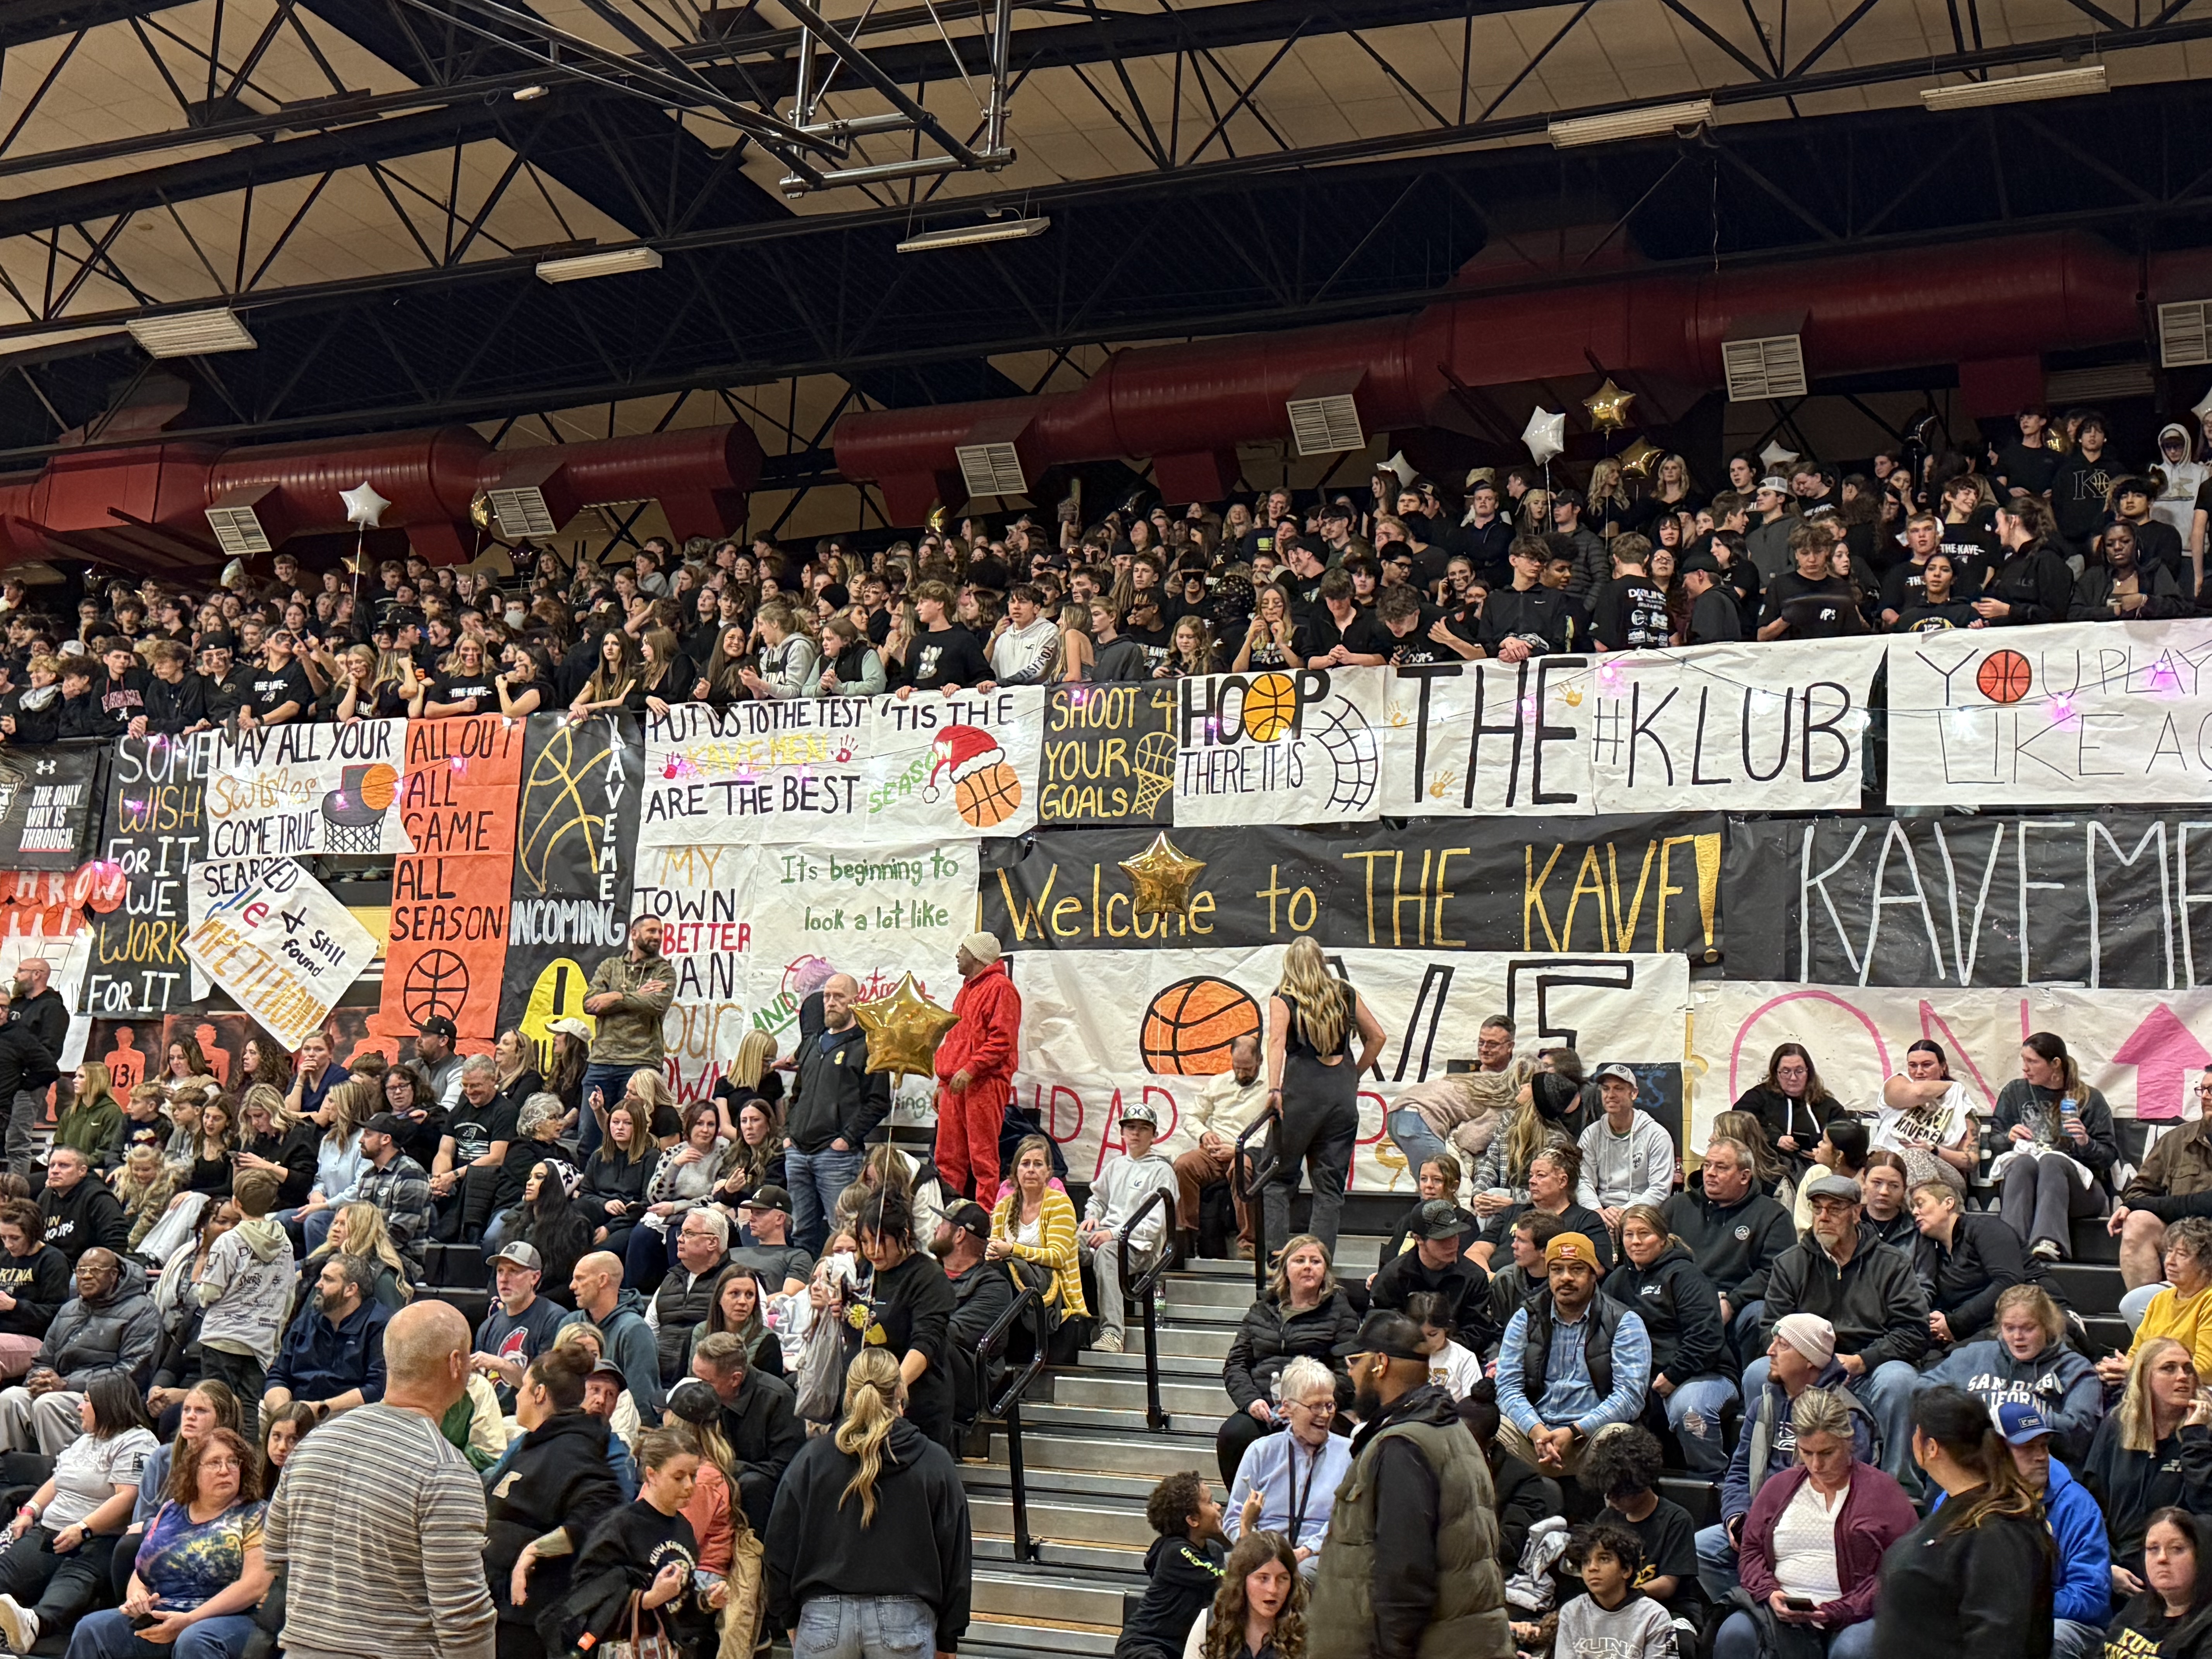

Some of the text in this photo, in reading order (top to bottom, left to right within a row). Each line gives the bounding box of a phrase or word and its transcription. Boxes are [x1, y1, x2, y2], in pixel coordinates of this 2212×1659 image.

[1940, 544, 1979, 555] THE KAVE
[2099, 646, 2212, 696] PLAY
[648, 698, 868, 742] PUT US TO THE TEST
[946, 694, 1013, 726] THE
[1051, 687, 1177, 732] SHOOT 4
[216, 720, 391, 769] MAY ALL YOUR
[410, 718, 520, 765] ALL OUT
[1396, 657, 1588, 808] THE
[1938, 711, 2125, 785] LIKE
[118, 733, 209, 784] SOME
[868, 740, 952, 814] SEASON
[1046, 738, 1130, 781] YOUR
[1179, 742, 1306, 796] THERE IT IS
[32, 785, 82, 806] THE ONLY
[120, 786, 201, 833] WISH
[407, 769, 458, 809] ALL
[645, 775, 860, 824] ARE THE BEST
[1040, 783, 1128, 821] GOALS
[20, 828, 74, 849] THROUGH.
[26, 806, 67, 828] WAY IS
[214, 809, 319, 857] COME TRUE
[404, 811, 494, 855] GAME
[155, 836, 200, 877] IT
[661, 845, 724, 888] MY
[781, 847, 959, 887] Its beginning to
[126, 880, 180, 916] WE
[395, 858, 457, 901] ALL
[996, 863, 1216, 941] Welcoe
[1256, 865, 1317, 934] to
[1343, 848, 1470, 947] THE
[390, 905, 504, 941] SEASON
[508, 899, 626, 947] INCOMING
[634, 887, 735, 922] TOWN
[805, 899, 949, 931] look a lot like
[100, 921, 188, 965] WORK
[280, 939, 325, 977] found
[662, 922, 751, 956] BETTER
[141, 971, 180, 1012] IT
[669, 951, 734, 1000] AN
[752, 992, 798, 1033] AND
[1967, 1373, 2009, 1391] SAN
